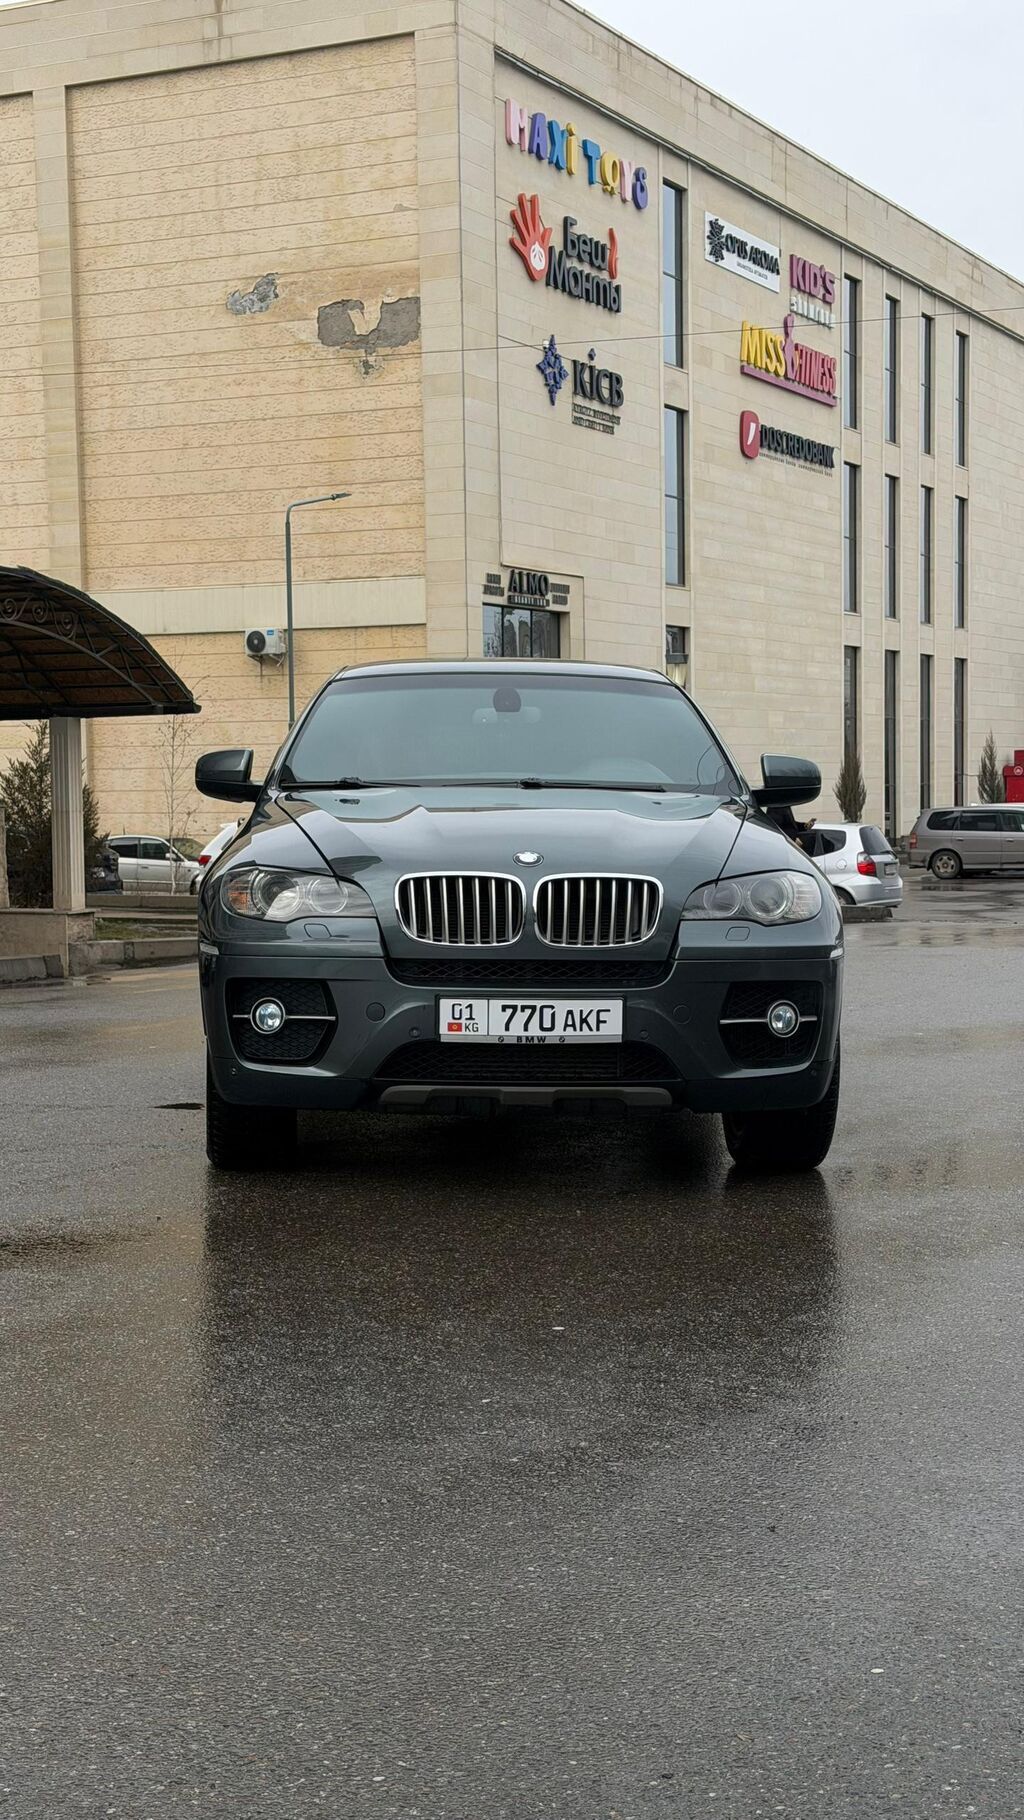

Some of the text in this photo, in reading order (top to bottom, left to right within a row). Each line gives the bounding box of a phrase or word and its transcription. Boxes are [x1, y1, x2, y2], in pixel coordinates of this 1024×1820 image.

[582, 138, 649, 210] TOYS
[563, 215, 608, 271] Беш
[748, 245, 780, 276] AROMA
[545, 245, 622, 313] Манты
[789, 253, 836, 305] KID'S
[740, 320, 837, 395] MISS FITNESS
[760, 424, 836, 469] DOSCREDOBANK
[507, 568, 550, 598] ALMO
[451, 1003, 611, 1032] 01 770 AKF
[464, 1022, 479, 1033] KG
